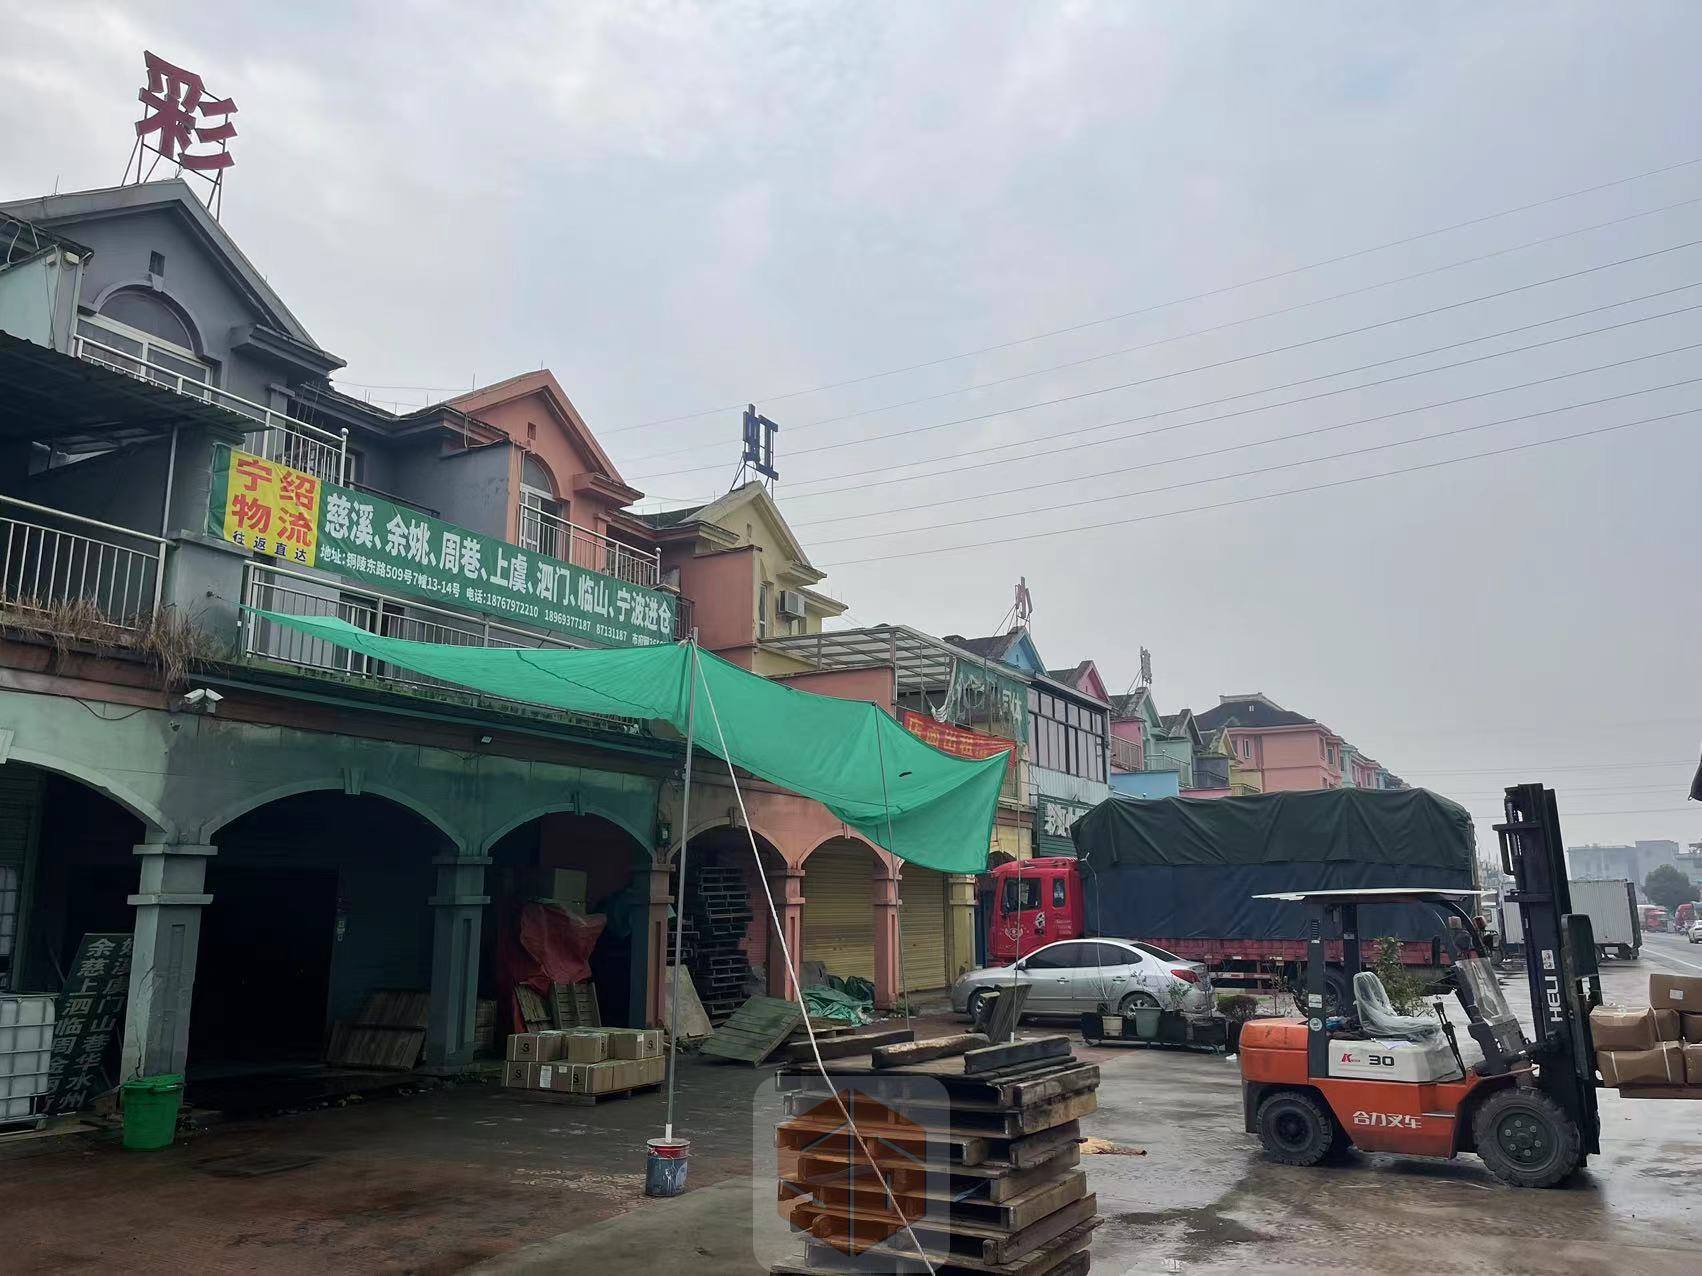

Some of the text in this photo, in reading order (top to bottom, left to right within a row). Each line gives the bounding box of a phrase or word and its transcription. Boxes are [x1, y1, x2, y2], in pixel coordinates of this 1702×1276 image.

[135, 50, 238, 170] 彩
[236, 458, 316, 511] 宁绍
[231, 494, 314, 547] 物流
[233, 530, 307, 562] 往返直达
[62, 996, 125, 1016] 泗门
[1545, 976, 1563, 1022] HELI
[54, 1016, 116, 1036] 临山
[1369, 1054, 1395, 1067] 30
[1352, 1111, 1422, 1129] 合力叉车
